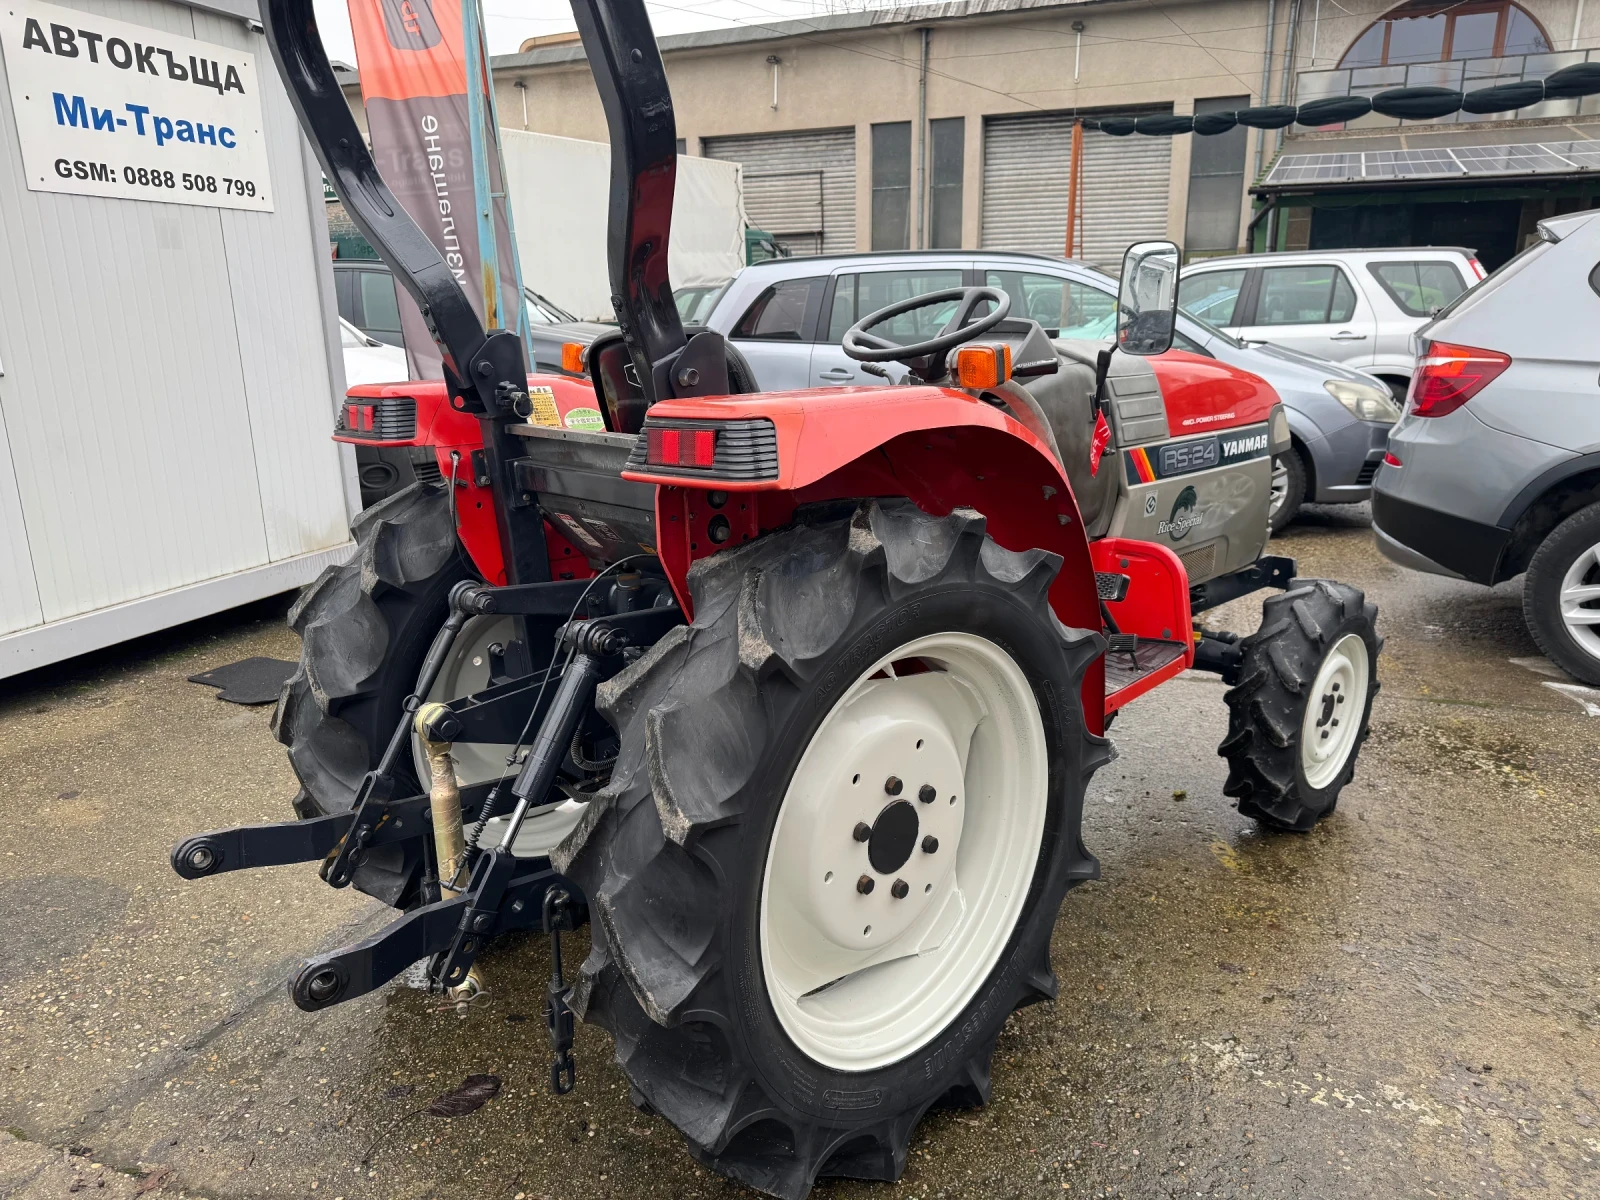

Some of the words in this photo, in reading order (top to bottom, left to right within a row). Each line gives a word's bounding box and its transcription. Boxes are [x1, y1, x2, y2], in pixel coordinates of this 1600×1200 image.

[23, 17, 245, 95] АВТОКЪЩА
[52, 92, 237, 149] Ми-Транс
[54, 158, 117, 183] GSM:
[123, 166, 176, 189] 0888
[182, 173, 218, 194] 508
[222, 178, 256, 198] 799
[323, 183, 335, 193] Tra
[1214, 412, 1236, 422] STEERING
[1164, 443, 1215, 471] RS-24
[1223, 434, 1268, 457] YANMAR
[1156, 519, 1175, 535] Rice
[1175, 512, 1204, 531] Special
[814, 671, 837, 707] AG
[838, 602, 922, 673] TRACTOR
[924, 946, 1046, 1079] BRIDGESTONE
